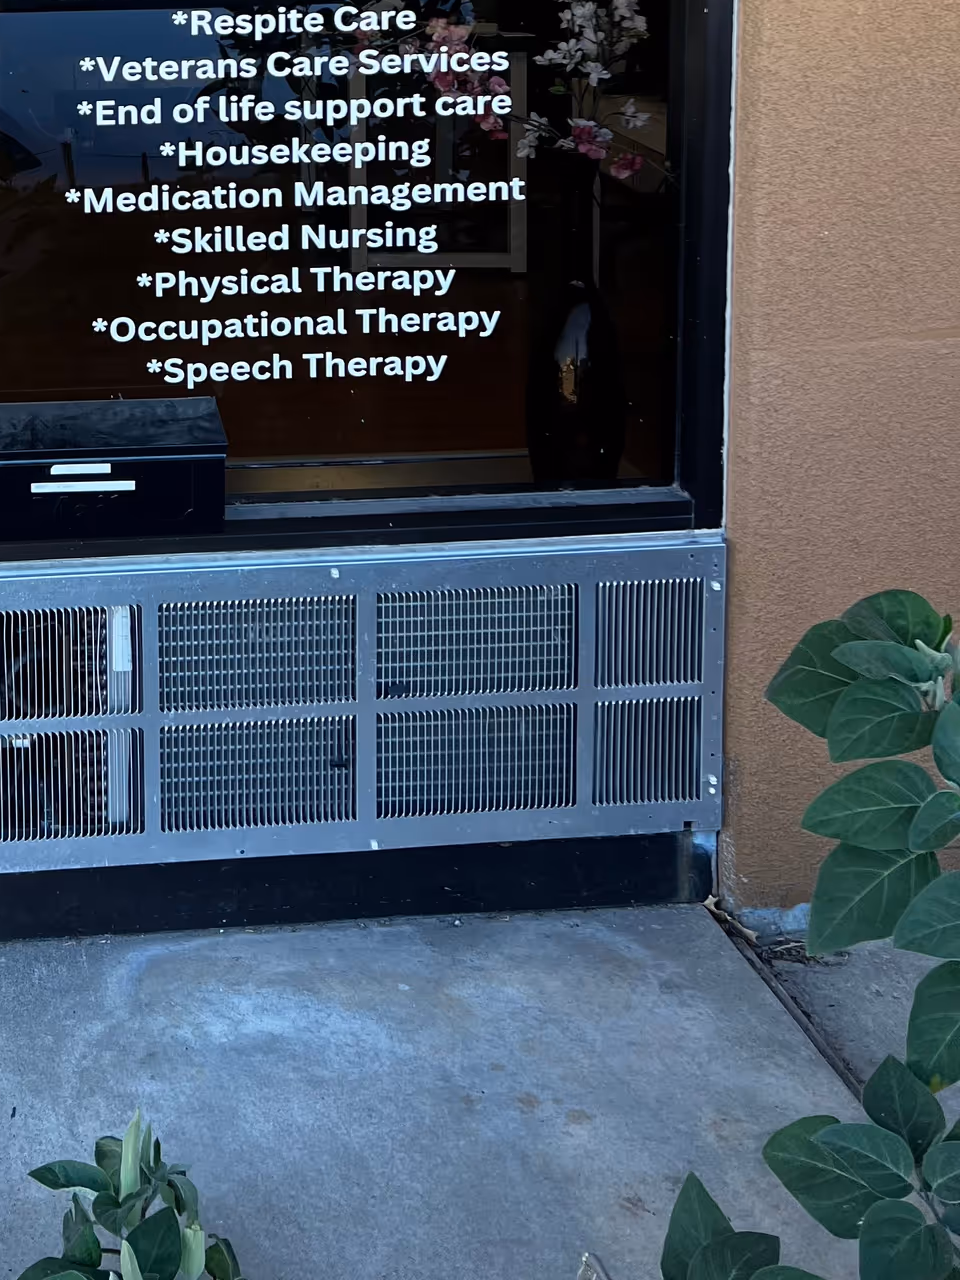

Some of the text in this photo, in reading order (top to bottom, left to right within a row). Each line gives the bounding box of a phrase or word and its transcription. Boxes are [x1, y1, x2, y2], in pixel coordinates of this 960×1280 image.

[333, 4, 417, 32] Care
[266, 50, 349, 79] Care
[358, 44, 510, 74] Services
[172, 95, 210, 124] of
[218, 94, 276, 123] life
[283, 93, 427, 126] support
[434, 93, 513, 118] care
[293, 176, 526, 212] Management
[300, 220, 438, 253] Nursing
[310, 266, 456, 296] Therapy
[355, 307, 501, 337] Therapy
[302, 351, 448, 382] Therapy
